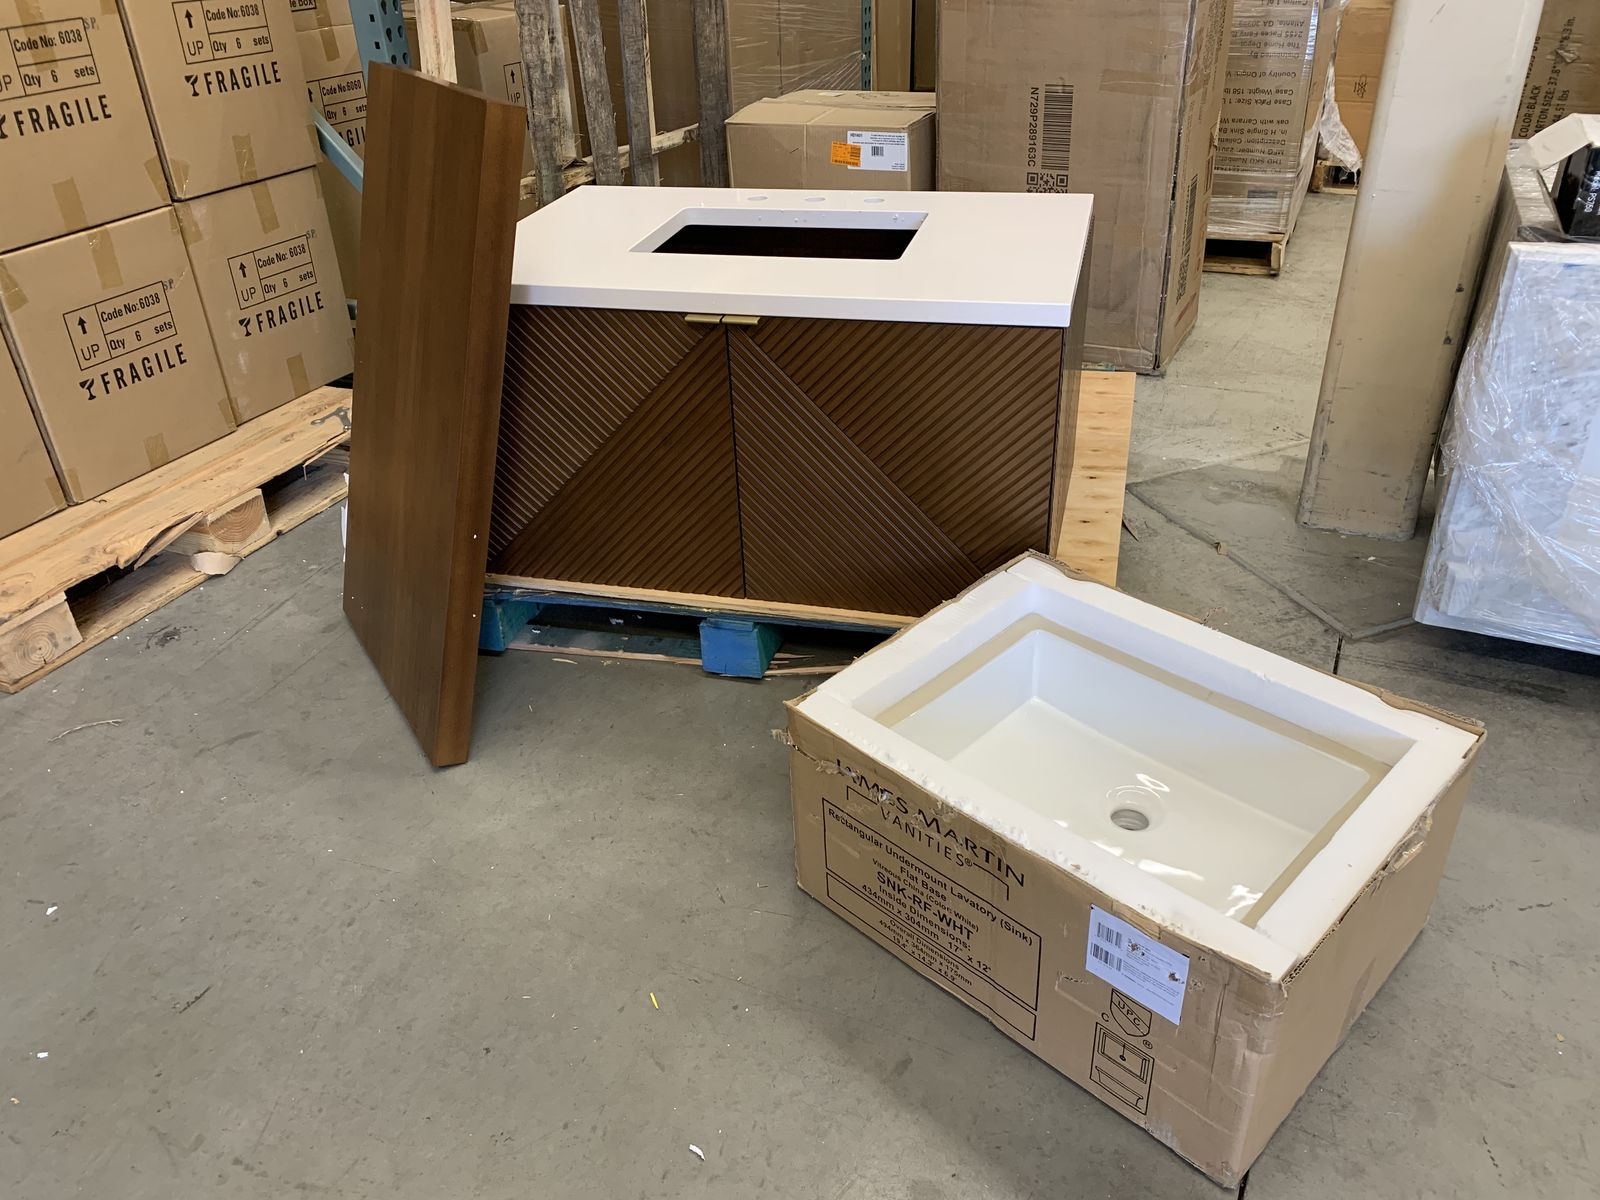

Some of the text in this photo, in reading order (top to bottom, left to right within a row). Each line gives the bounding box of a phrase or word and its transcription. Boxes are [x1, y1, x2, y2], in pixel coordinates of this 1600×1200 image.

[205, 3, 260, 22] Code No: 6038
[13, 28, 82, 52] Code No: 6038
[187, 40, 204, 56] UP
[212, 35, 270, 53] Qty 6 sets
[0, 74, 12, 92] P
[23, 65, 95, 88] Qty 6 sets
[204, 61, 282, 95] FRAGILE
[1268, 70, 1296, 78] Country
[322, 85, 337, 96] Code
[510, 92, 520, 104] UP
[1248, 87, 1273, 96] Weight:
[1274, 98, 1292, 106] Case
[1276, 88, 1294, 96] Case
[1559, 90, 1570, 104] lbs
[13, 94, 112, 136] FRAGILE
[326, 110, 336, 120] Qty
[1518, 85, 1542, 138] COLOR:BLACK
[1534, 107, 1549, 134] ARTON
[1028, 86, 1040, 168] N729P289163C
[1247, 128, 1268, 136] Single
[257, 243, 306, 268] Code No: 6038
[241, 286, 256, 302] UP
[264, 270, 314, 294] Qty 6 sets
[100, 292, 161, 322] Code No: 6038
[256, 291, 324, 332] FRAGILE
[110, 320, 173, 351] Qty 6 sets
[80, 343, 100, 361] UP
[100, 343, 188, 395] FRAGILE
[918, 808, 1024, 888] MARTIN
[828, 808, 1033, 946] Rectangular Undermount Lavatory (Sink)
[900, 866, 947, 902] Flat Base
[872, 858, 979, 932] Vitreous China (Color: White)
[877, 871, 974, 941] SNK-RF-WHT
[862, 884, 894, 910] 434mm
[896, 908, 902, 916] x
[904, 912, 940, 940] 304mm
[967, 955, 974, 963] x
[879, 885, 971, 952] Inside Dimensions:
[890, 920, 960, 970] Overall Dimensions
[1118, 1000, 1141, 1026] UPC
